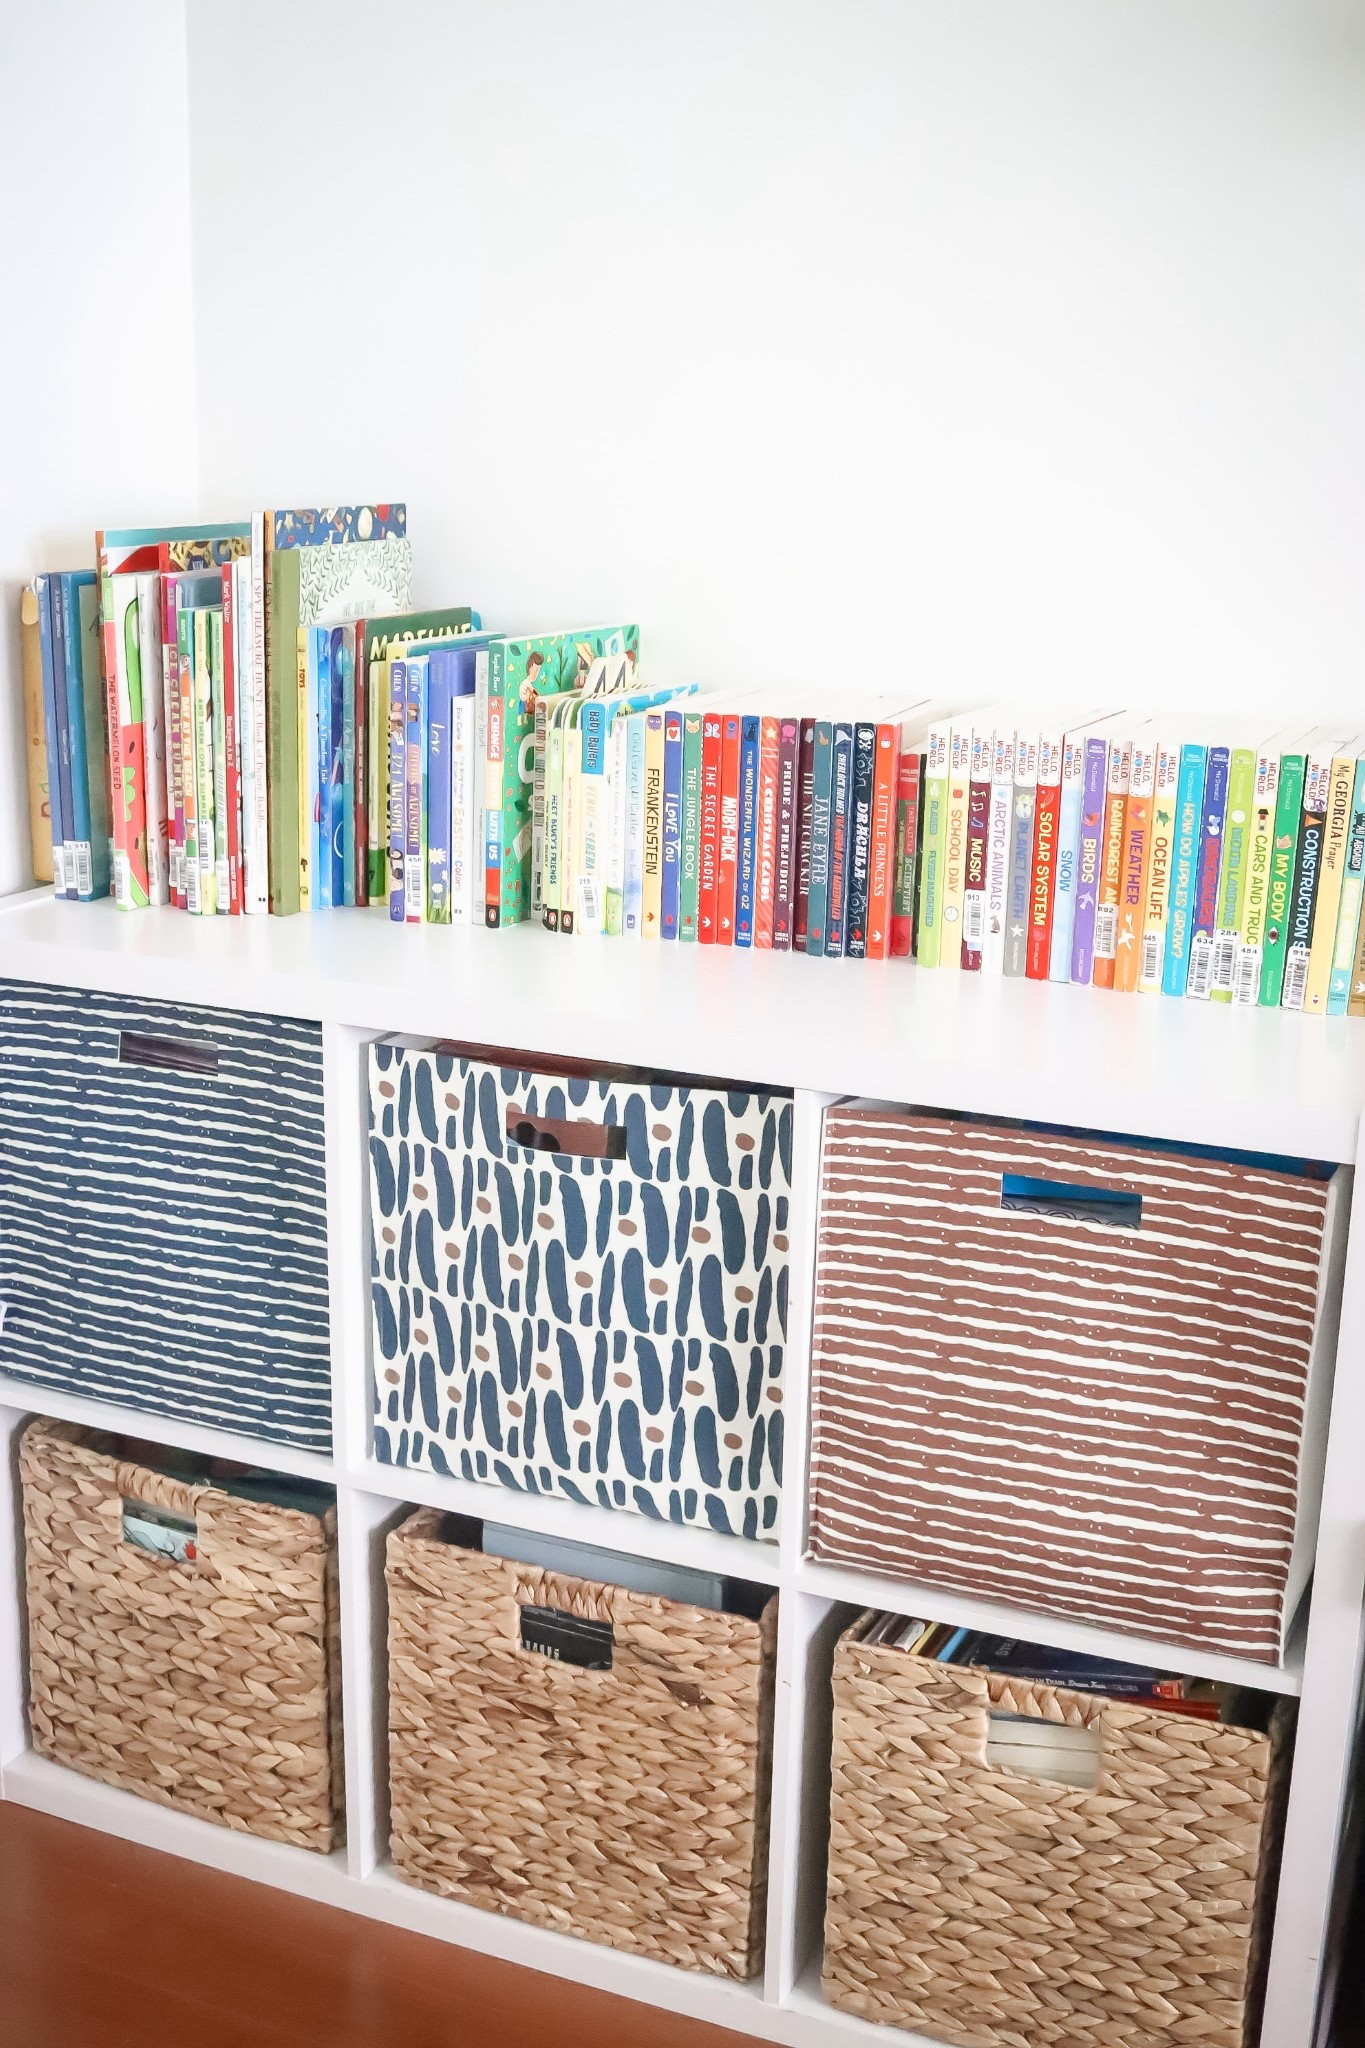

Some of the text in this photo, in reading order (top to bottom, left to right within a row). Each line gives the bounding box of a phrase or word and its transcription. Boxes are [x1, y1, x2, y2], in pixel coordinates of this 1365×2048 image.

[394, 670, 402, 692] CHEN
[110, 696, 120, 763] WATERMELON
[430, 723, 445, 757] Love
[490, 714, 500, 760] CHANGE
[586, 711, 600, 768] Baby Ballers
[113, 766, 121, 789] SEED
[837, 754, 846, 786] SHERLOCK
[1004, 745, 1012, 772] HELLO,
[1026, 746, 1035, 772] HELLO,
[1050, 746, 1058, 774] HELLO,
[1072, 749, 1082, 776] HELLO,
[1120, 752, 1129, 780] HELLO,
[1142, 755, 1151, 783] HELLO,
[1166, 756, 1176, 784] HELLO,
[1212, 770, 1222, 802] McDonald
[1266, 762, 1276, 791] HELLO,
[1317, 768, 1328, 798] HELLO,
[645, 768, 660, 874] FRANKENSTEIN
[684, 768, 696, 880] THE JUNGLE BOOK
[702, 765, 716, 890] THE SECRET GARDEN
[743, 768, 754, 834] WONDERFUL
[836, 787, 845, 814] HOLMES
[1325, 764, 1350, 870] My GEORGIA Prayer
[453, 807, 464, 893] Easter Colors
[488, 845, 498, 860] US
[720, 796, 736, 862] MOBY-DICK
[760, 775, 773, 902] A CHRISTMAS CAROL
[779, 760, 792, 902] PRIDE & PREJUDICE
[799, 803, 812, 895] NUTCRACKER
[812, 795, 828, 886] JANE EYRE
[854, 801, 870, 879] DRACULA
[874, 782, 888, 896] A LITTLE PRINCESS
[947, 810, 962, 893] SCHOOL DAY
[989, 801, 1006, 910] ARCTIC ANIMALS
[1104, 800, 1123, 884] RAINFOREST
[1350, 839, 1364, 870] ABOARD!
[742, 838, 752, 880] WIZARD
[902, 858, 912, 912] SCIENTIST
[969, 838, 982, 882] MUSIC
[1012, 822, 1028, 919] PLANET EARTH
[1033, 812, 1052, 926] SOLAR SYSTEM
[1060, 850, 1072, 892] SNOW
[1082, 838, 1096, 884] BIRDS
[1126, 830, 1144, 905] WEATHER
[1149, 837, 1168, 920] OCEAN LIFE
[1250, 834, 1268, 905] CARS AND
[1293, 830, 1318, 938] CONSTRUCTION
[741, 895, 750, 910] OZ
[1223, 871, 1238, 926] LANDING
[1270, 854, 1290, 922] MY BODY
